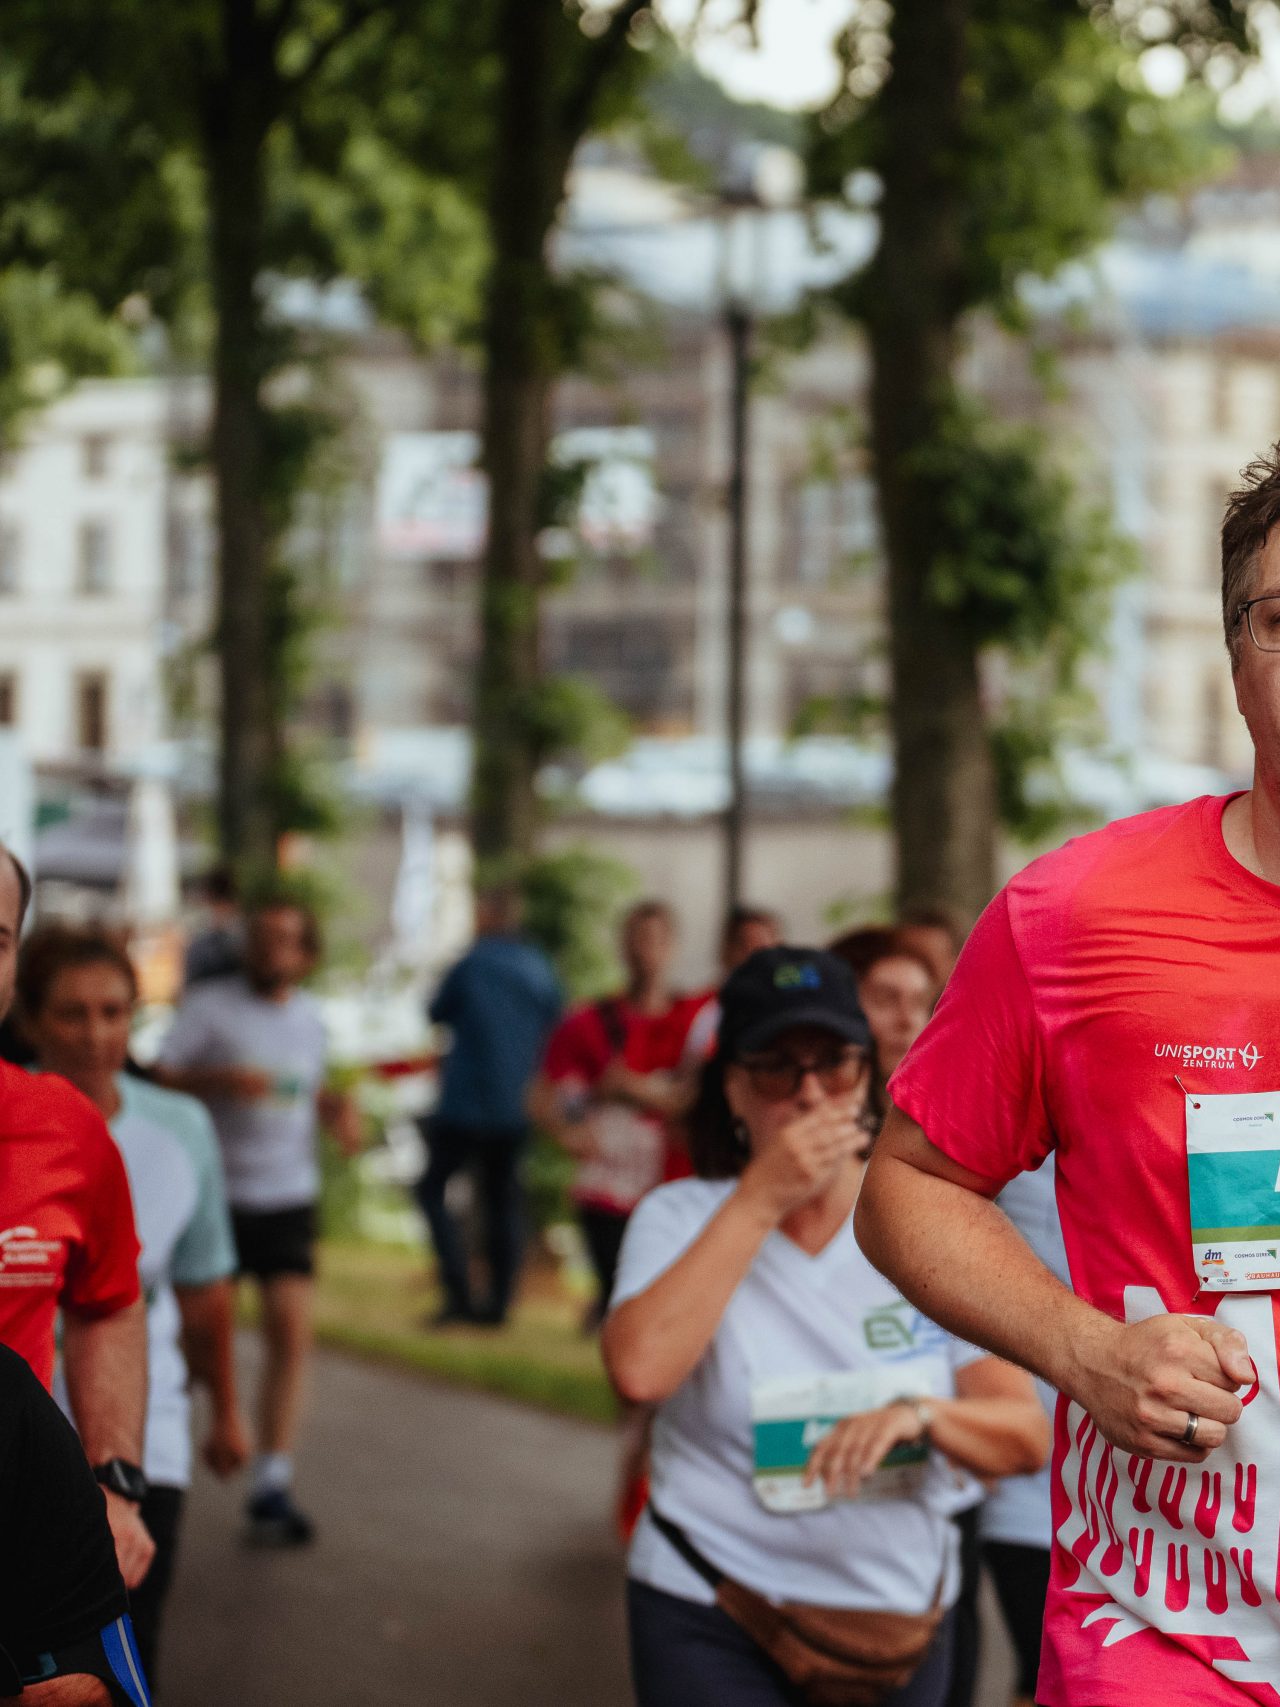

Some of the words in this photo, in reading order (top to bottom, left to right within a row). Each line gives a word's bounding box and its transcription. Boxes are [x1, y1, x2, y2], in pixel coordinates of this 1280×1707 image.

[1154, 1044, 1236, 1061] UNISPORT
[1183, 1059, 1235, 1069] ZENTRUM
[1205, 1249, 1222, 1260] dm
